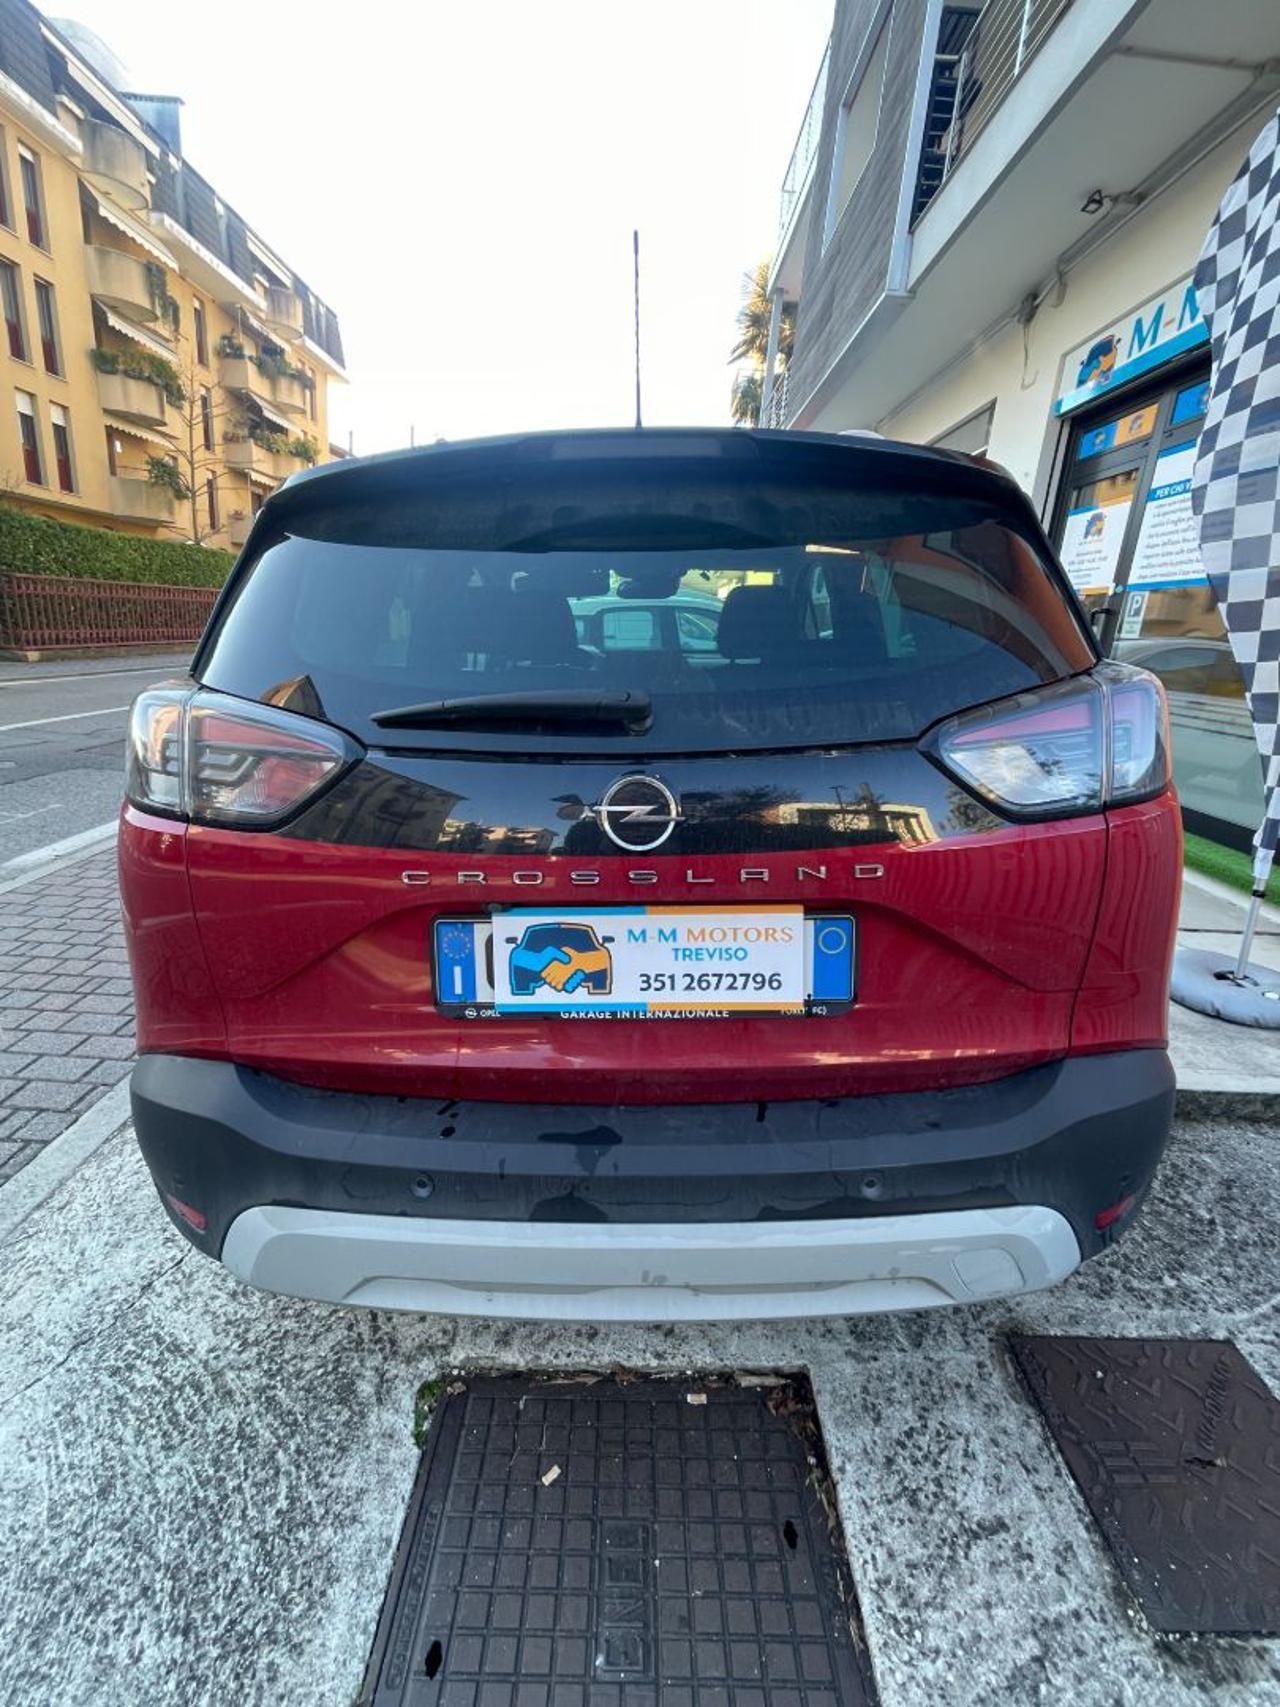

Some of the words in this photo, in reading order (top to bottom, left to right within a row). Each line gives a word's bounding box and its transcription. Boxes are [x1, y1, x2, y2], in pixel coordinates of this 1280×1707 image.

[1130, 595, 1142, 616] P
[401, 863, 885, 885] CROSSLAND
[627, 927, 678, 943] M-M
[686, 927, 793, 943] MOTORS
[672, 947, 749, 961] TREVISO
[480, 1004, 501, 1017] OPEL
[617, 1008, 730, 1019] INTERNAZIONALE
